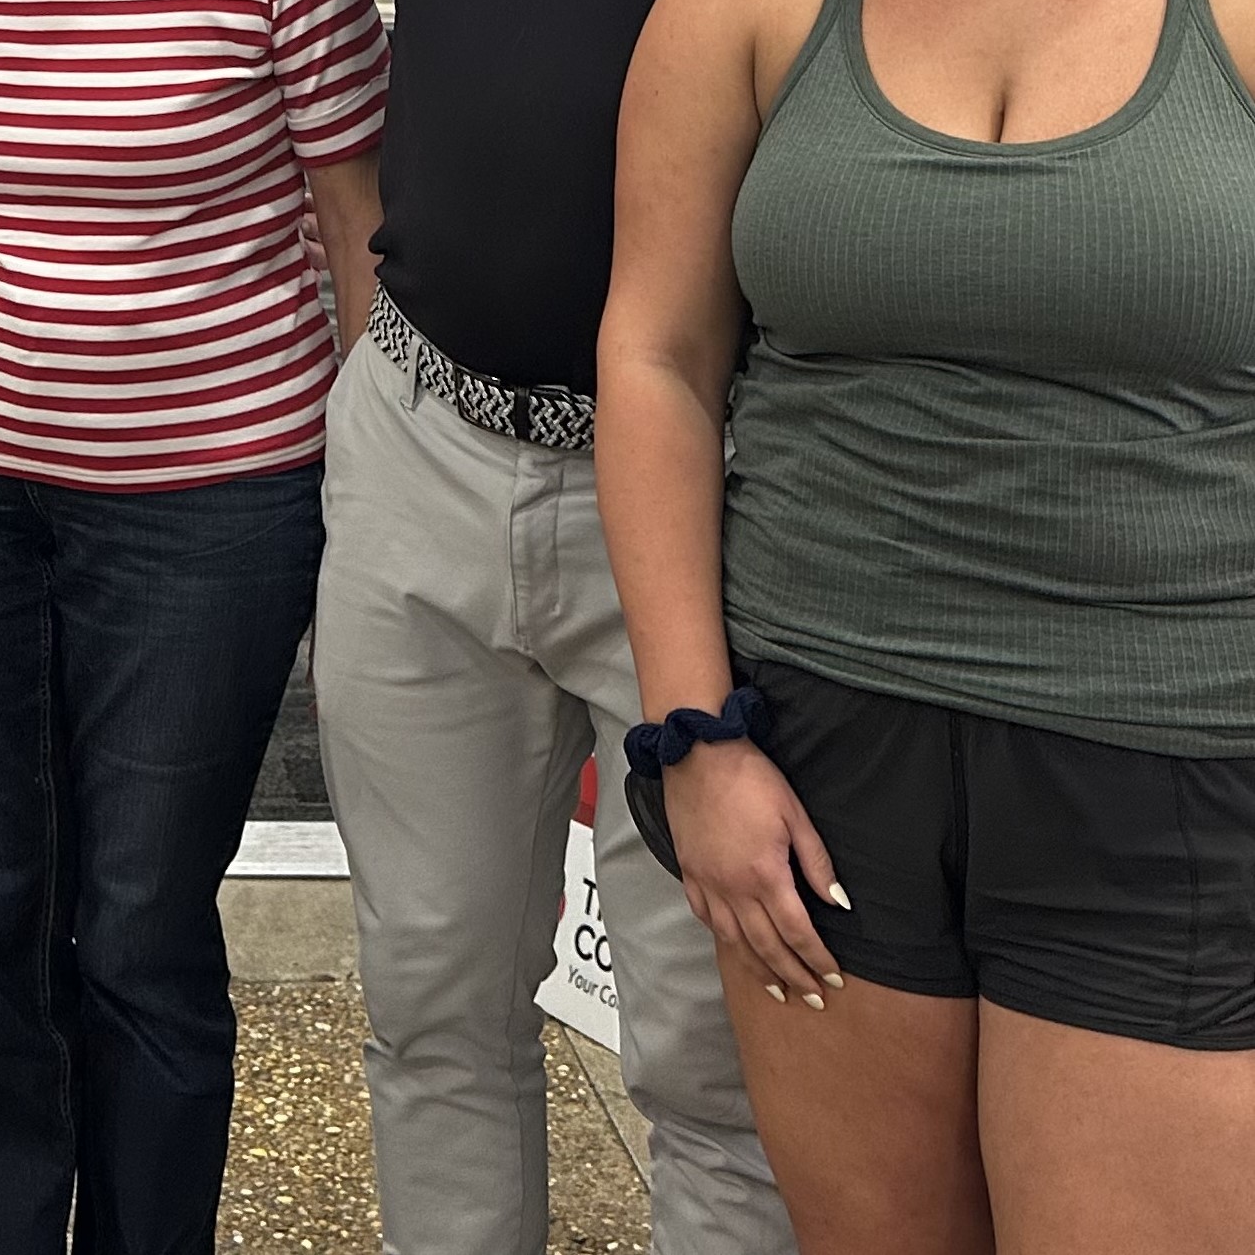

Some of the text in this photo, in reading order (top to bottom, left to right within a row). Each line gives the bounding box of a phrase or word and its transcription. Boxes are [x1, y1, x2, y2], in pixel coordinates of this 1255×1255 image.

[583, 877, 601, 921] T
[568, 965, 619, 1009] Your Co
